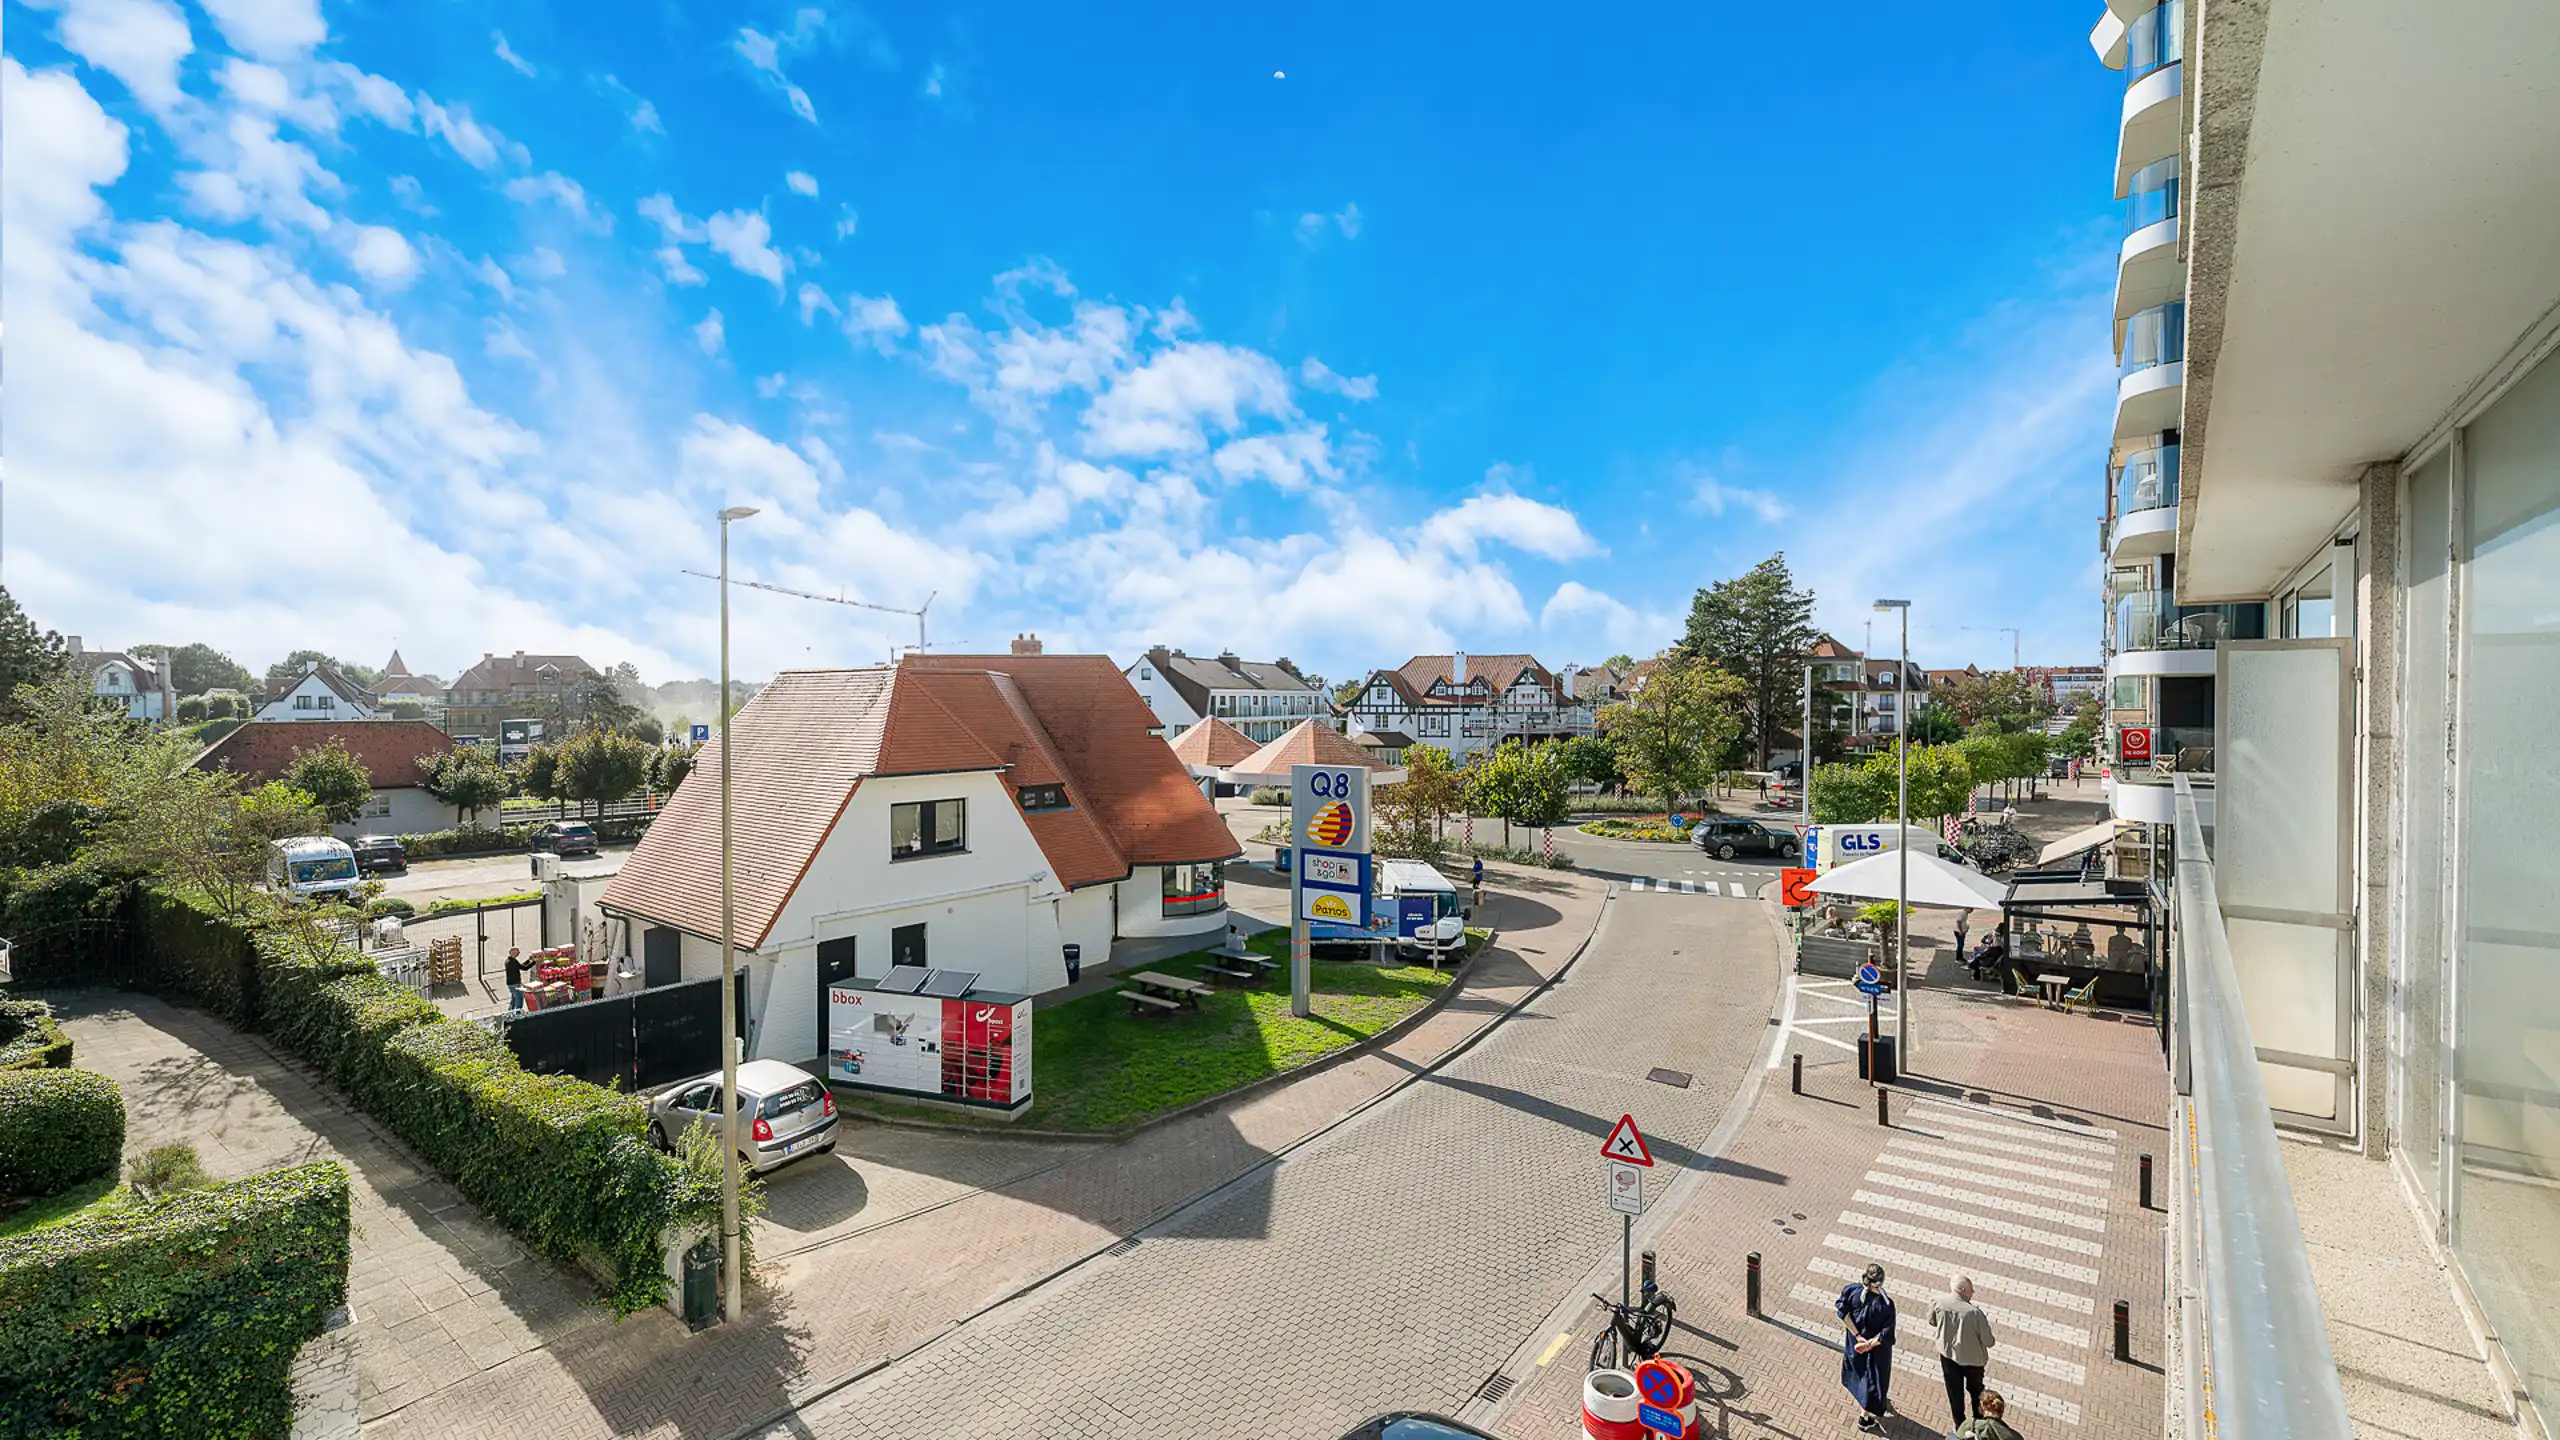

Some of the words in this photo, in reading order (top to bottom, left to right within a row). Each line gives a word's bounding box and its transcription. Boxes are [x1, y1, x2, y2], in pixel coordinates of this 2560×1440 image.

[697, 727, 704, 737] P
[1310, 771, 1350, 798] Q8
[1312, 858, 1335, 869] shop
[1317, 869, 1335, 879] &go
[1316, 905, 1347, 917] Panos
[832, 991, 862, 1006] bbox
